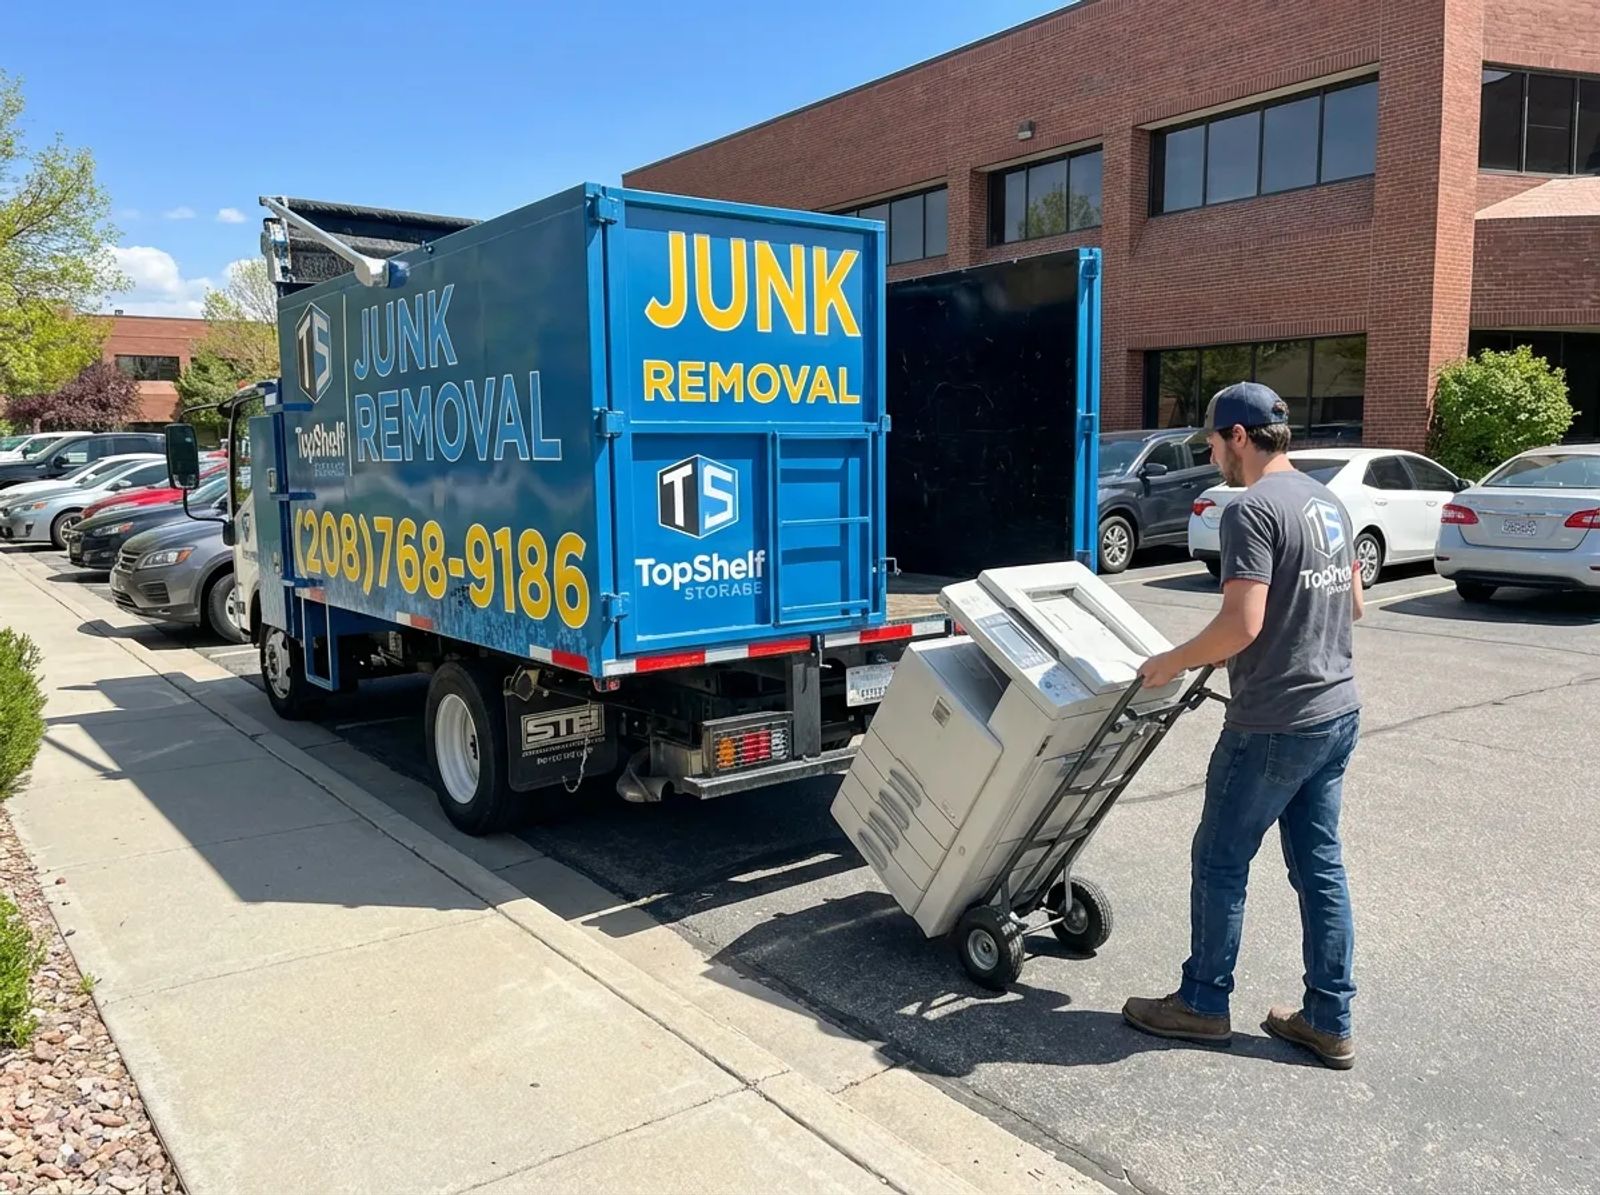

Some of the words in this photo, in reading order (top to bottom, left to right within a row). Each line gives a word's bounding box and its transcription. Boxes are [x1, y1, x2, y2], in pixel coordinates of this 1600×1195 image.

[645, 230, 861, 337] JUNK
[298, 311, 331, 392] TS
[353, 284, 458, 380] JUNK
[354, 370, 563, 463] REMOVAL
[643, 359, 860, 404] REMOVAL
[662, 463, 734, 530] TS
[294, 508, 591, 630] (208)768-9186
[634, 549, 766, 591] TopShelf
